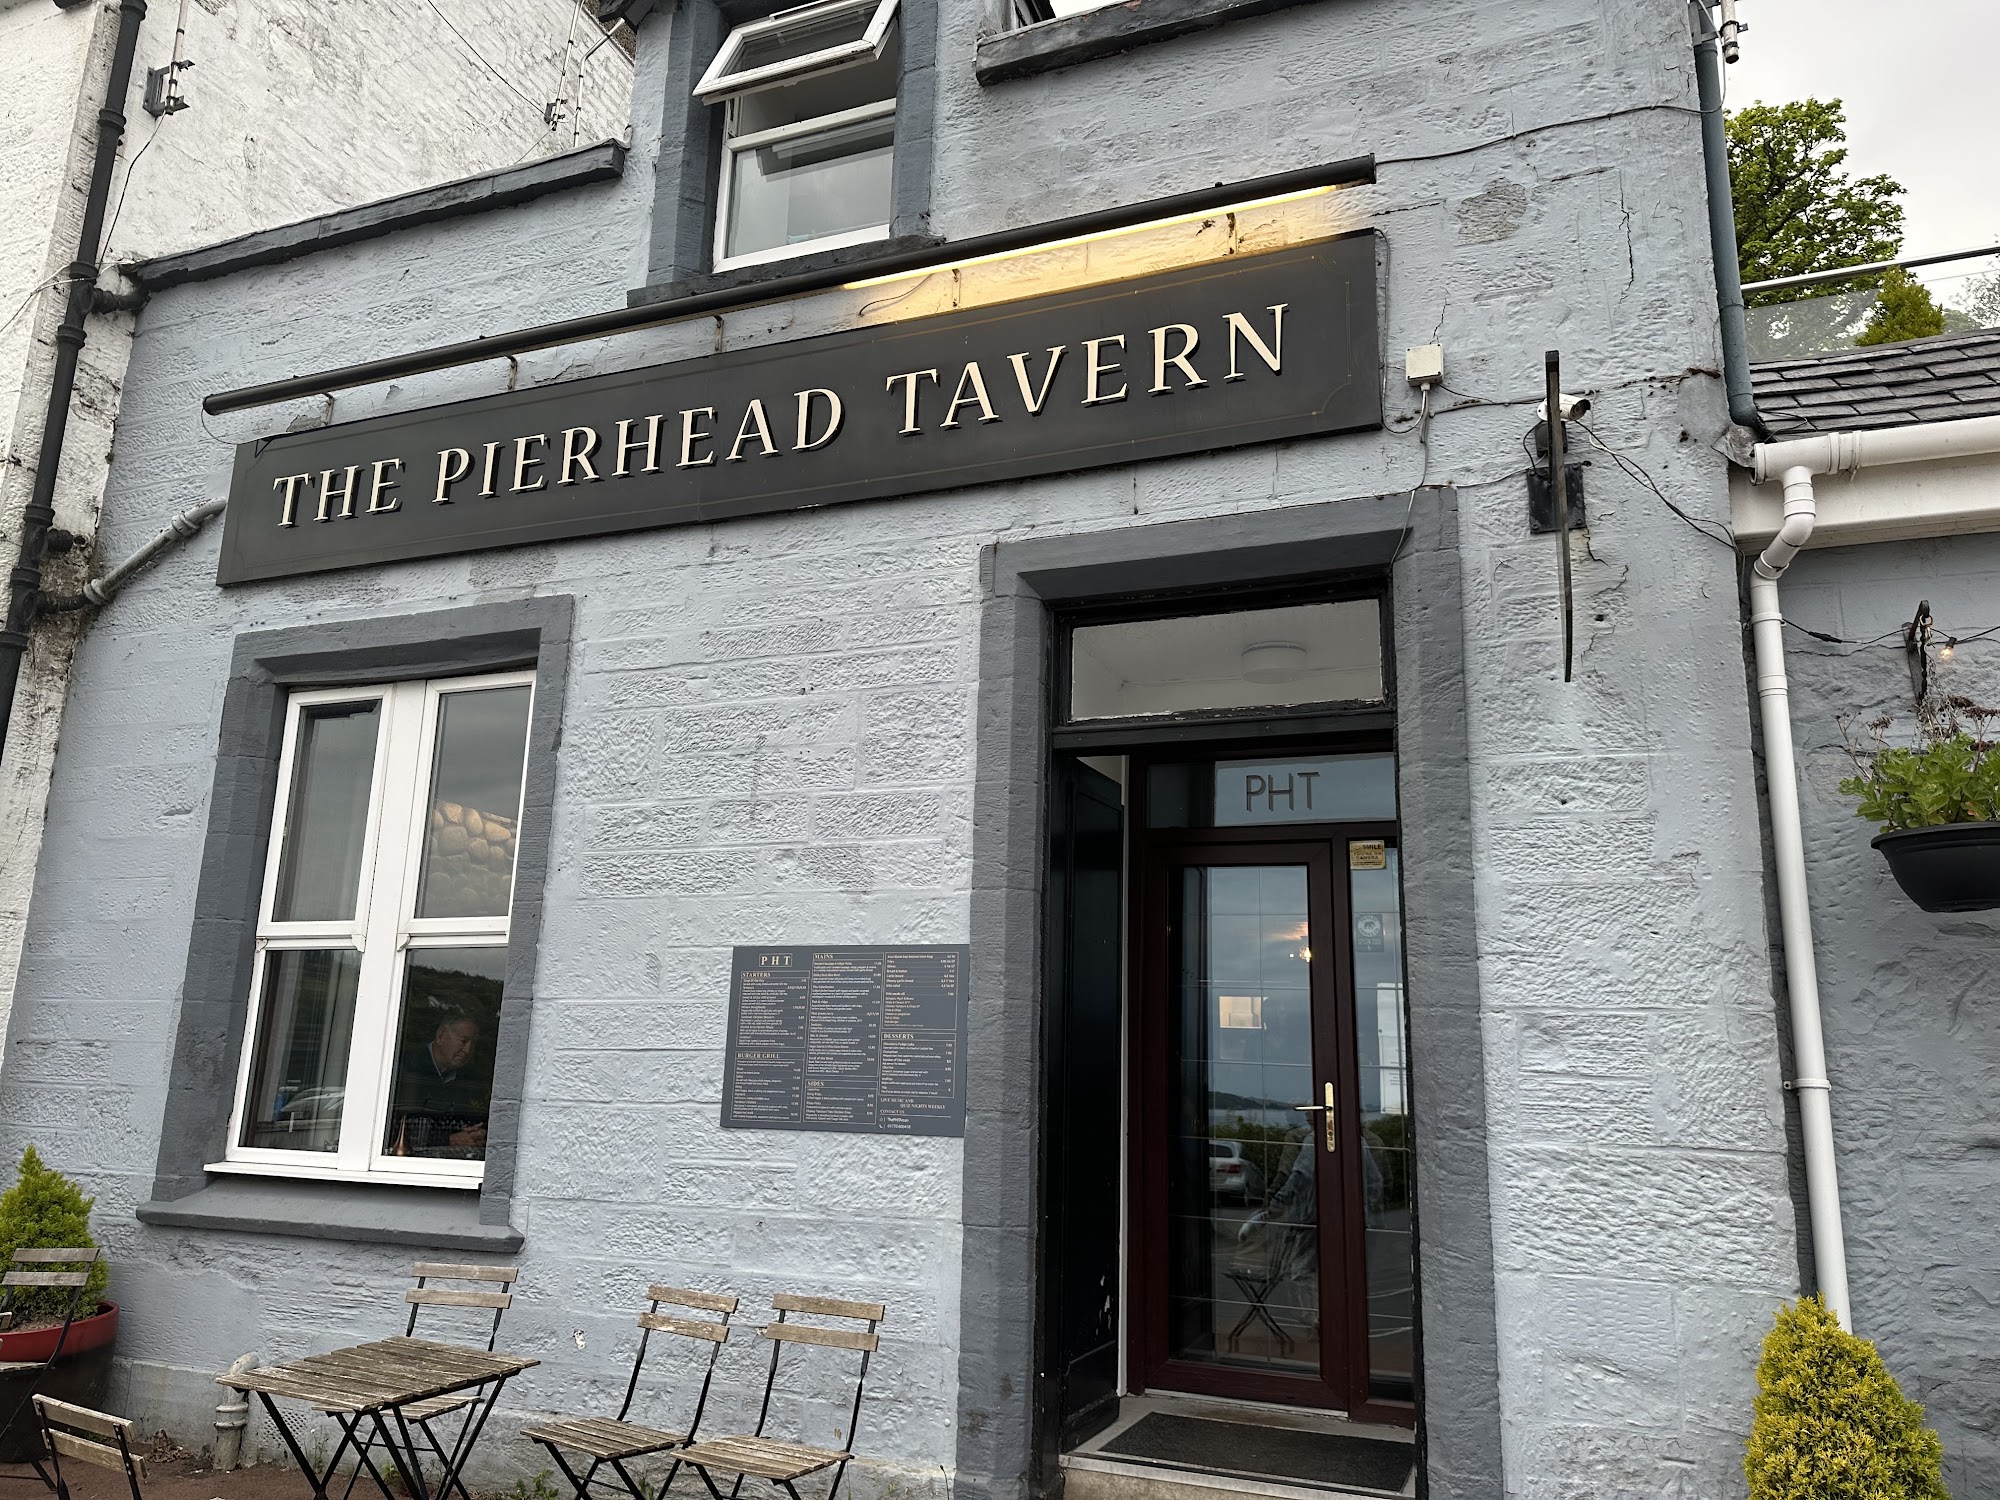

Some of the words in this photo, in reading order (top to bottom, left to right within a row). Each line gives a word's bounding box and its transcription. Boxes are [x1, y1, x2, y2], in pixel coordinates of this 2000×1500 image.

[272, 458, 403, 527] THE
[432, 388, 843, 504] PIERHEAD
[886, 303, 1289, 435] TAVERN
[1246, 772, 1320, 812] PHT
